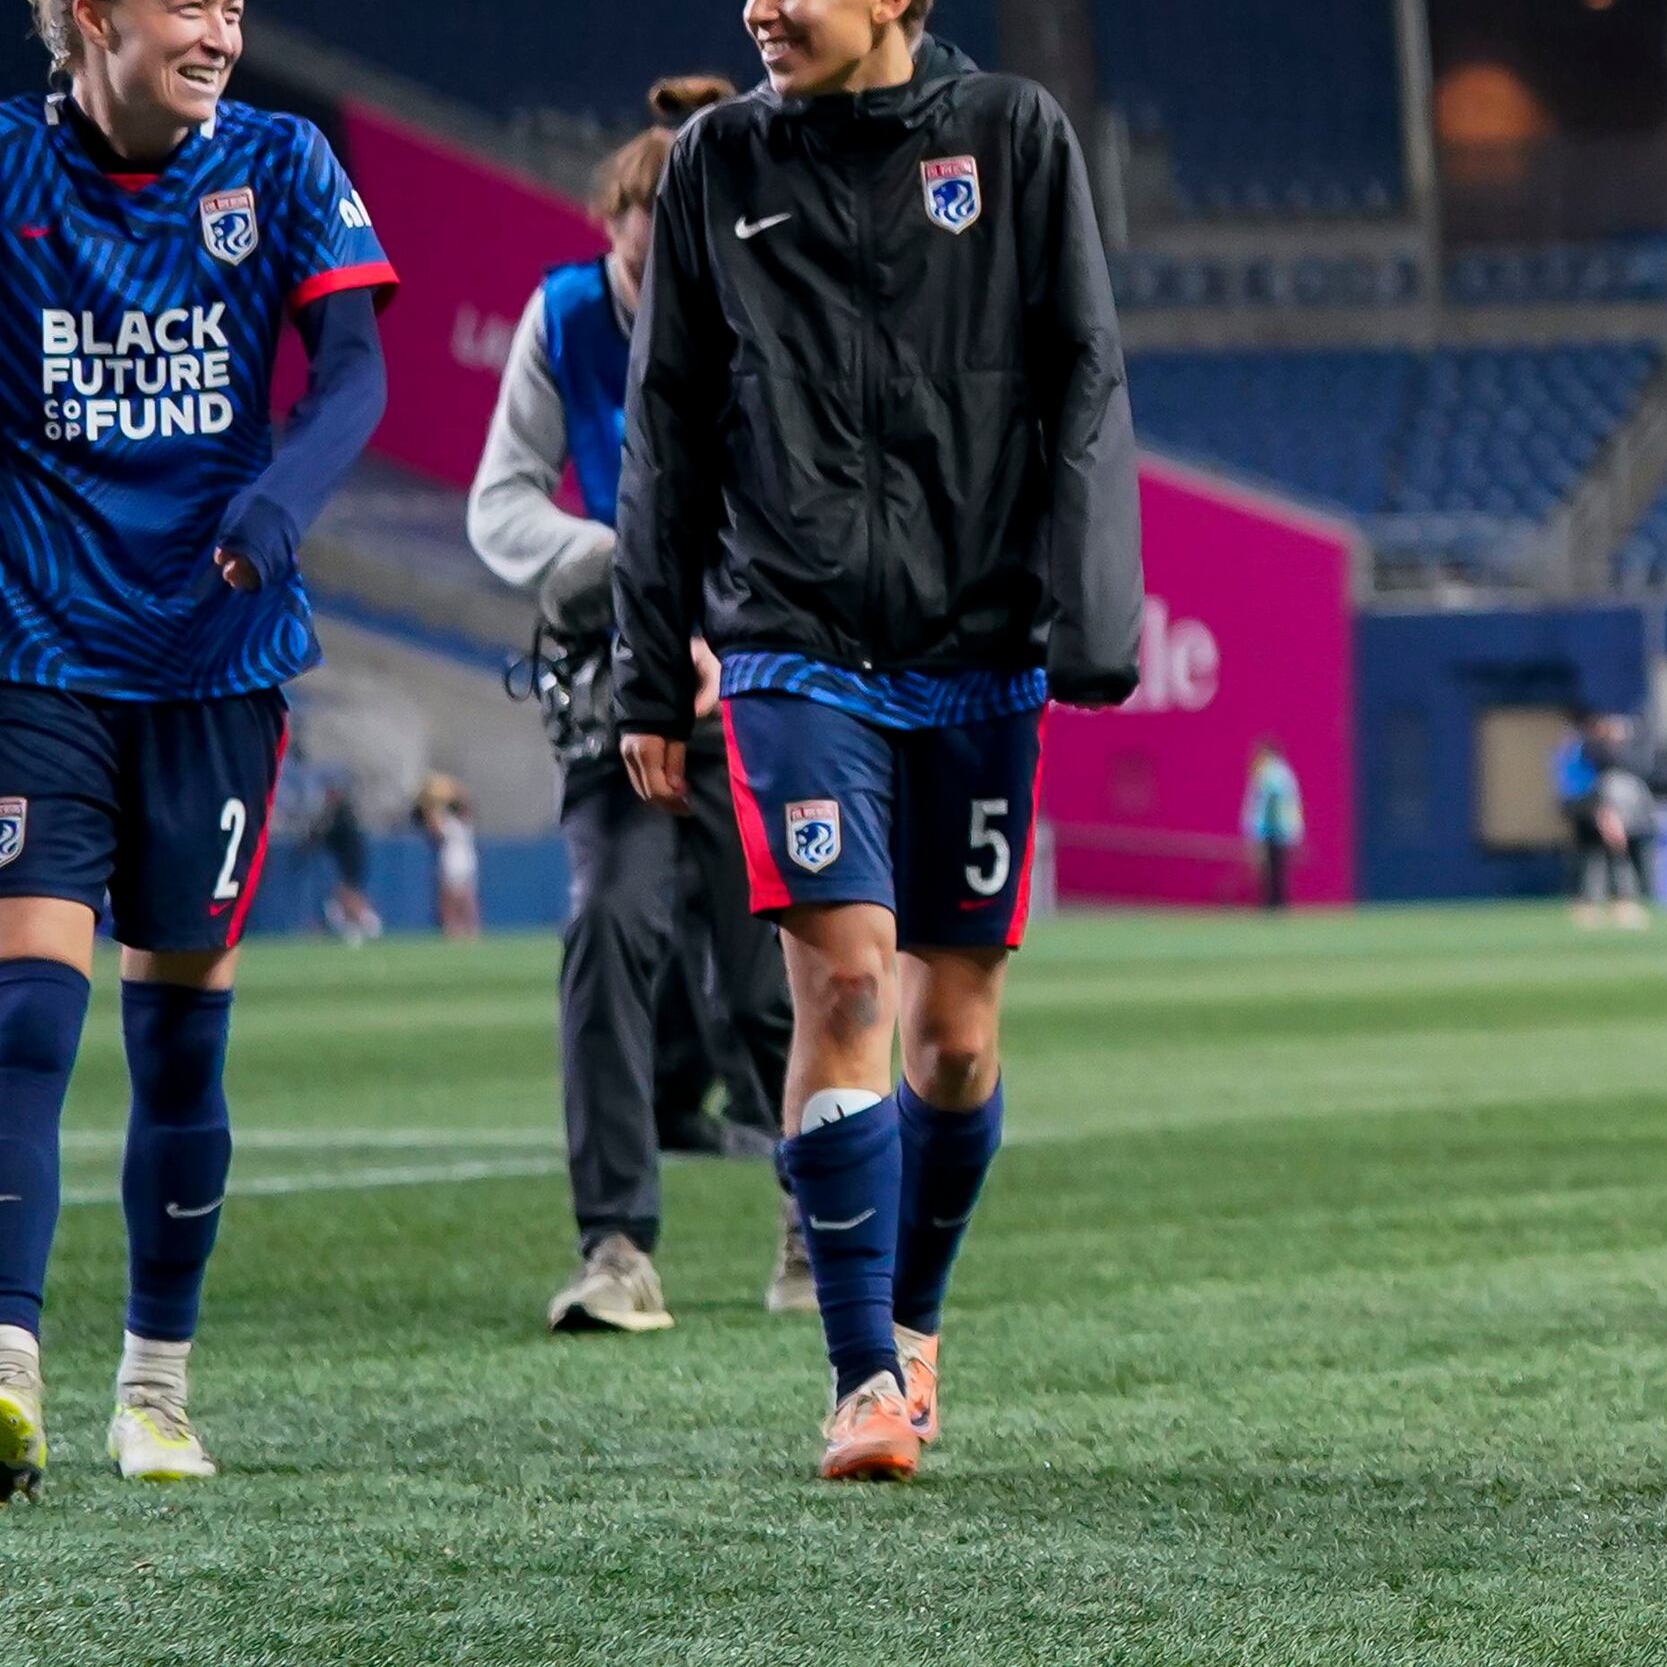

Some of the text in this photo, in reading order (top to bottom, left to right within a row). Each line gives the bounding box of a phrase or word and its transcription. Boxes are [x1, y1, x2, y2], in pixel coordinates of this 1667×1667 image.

[42, 301, 229, 355] BLACK
[43, 349, 230, 396] FUTURE
[43, 399, 82, 420] CO
[44, 391, 234, 442] OP FUND
[213, 797, 246, 900] 2
[965, 798, 1011, 896] 5
